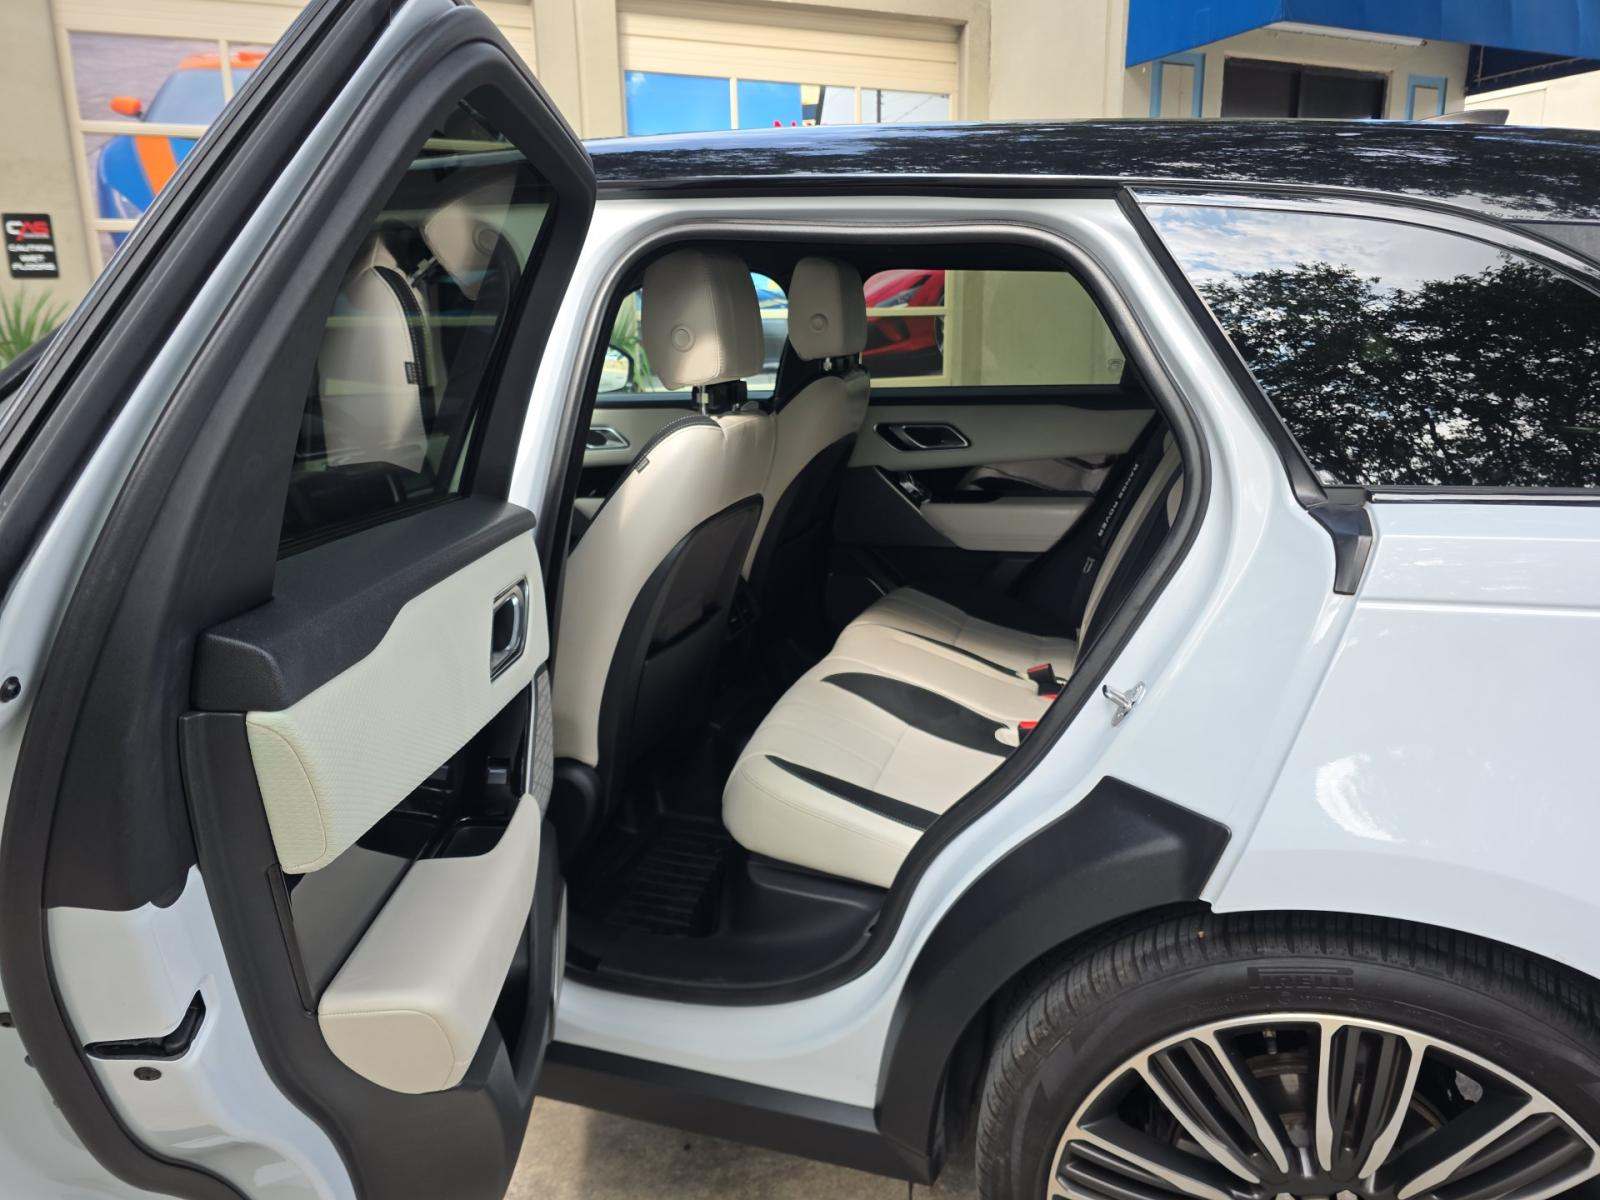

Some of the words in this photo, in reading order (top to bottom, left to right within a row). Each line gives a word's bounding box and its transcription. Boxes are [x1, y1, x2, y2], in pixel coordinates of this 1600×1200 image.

[1119, 463, 1138, 499] RANGE
[1097, 501, 1119, 537] ROVER
[1247, 967, 1354, 991] PIRELLI
